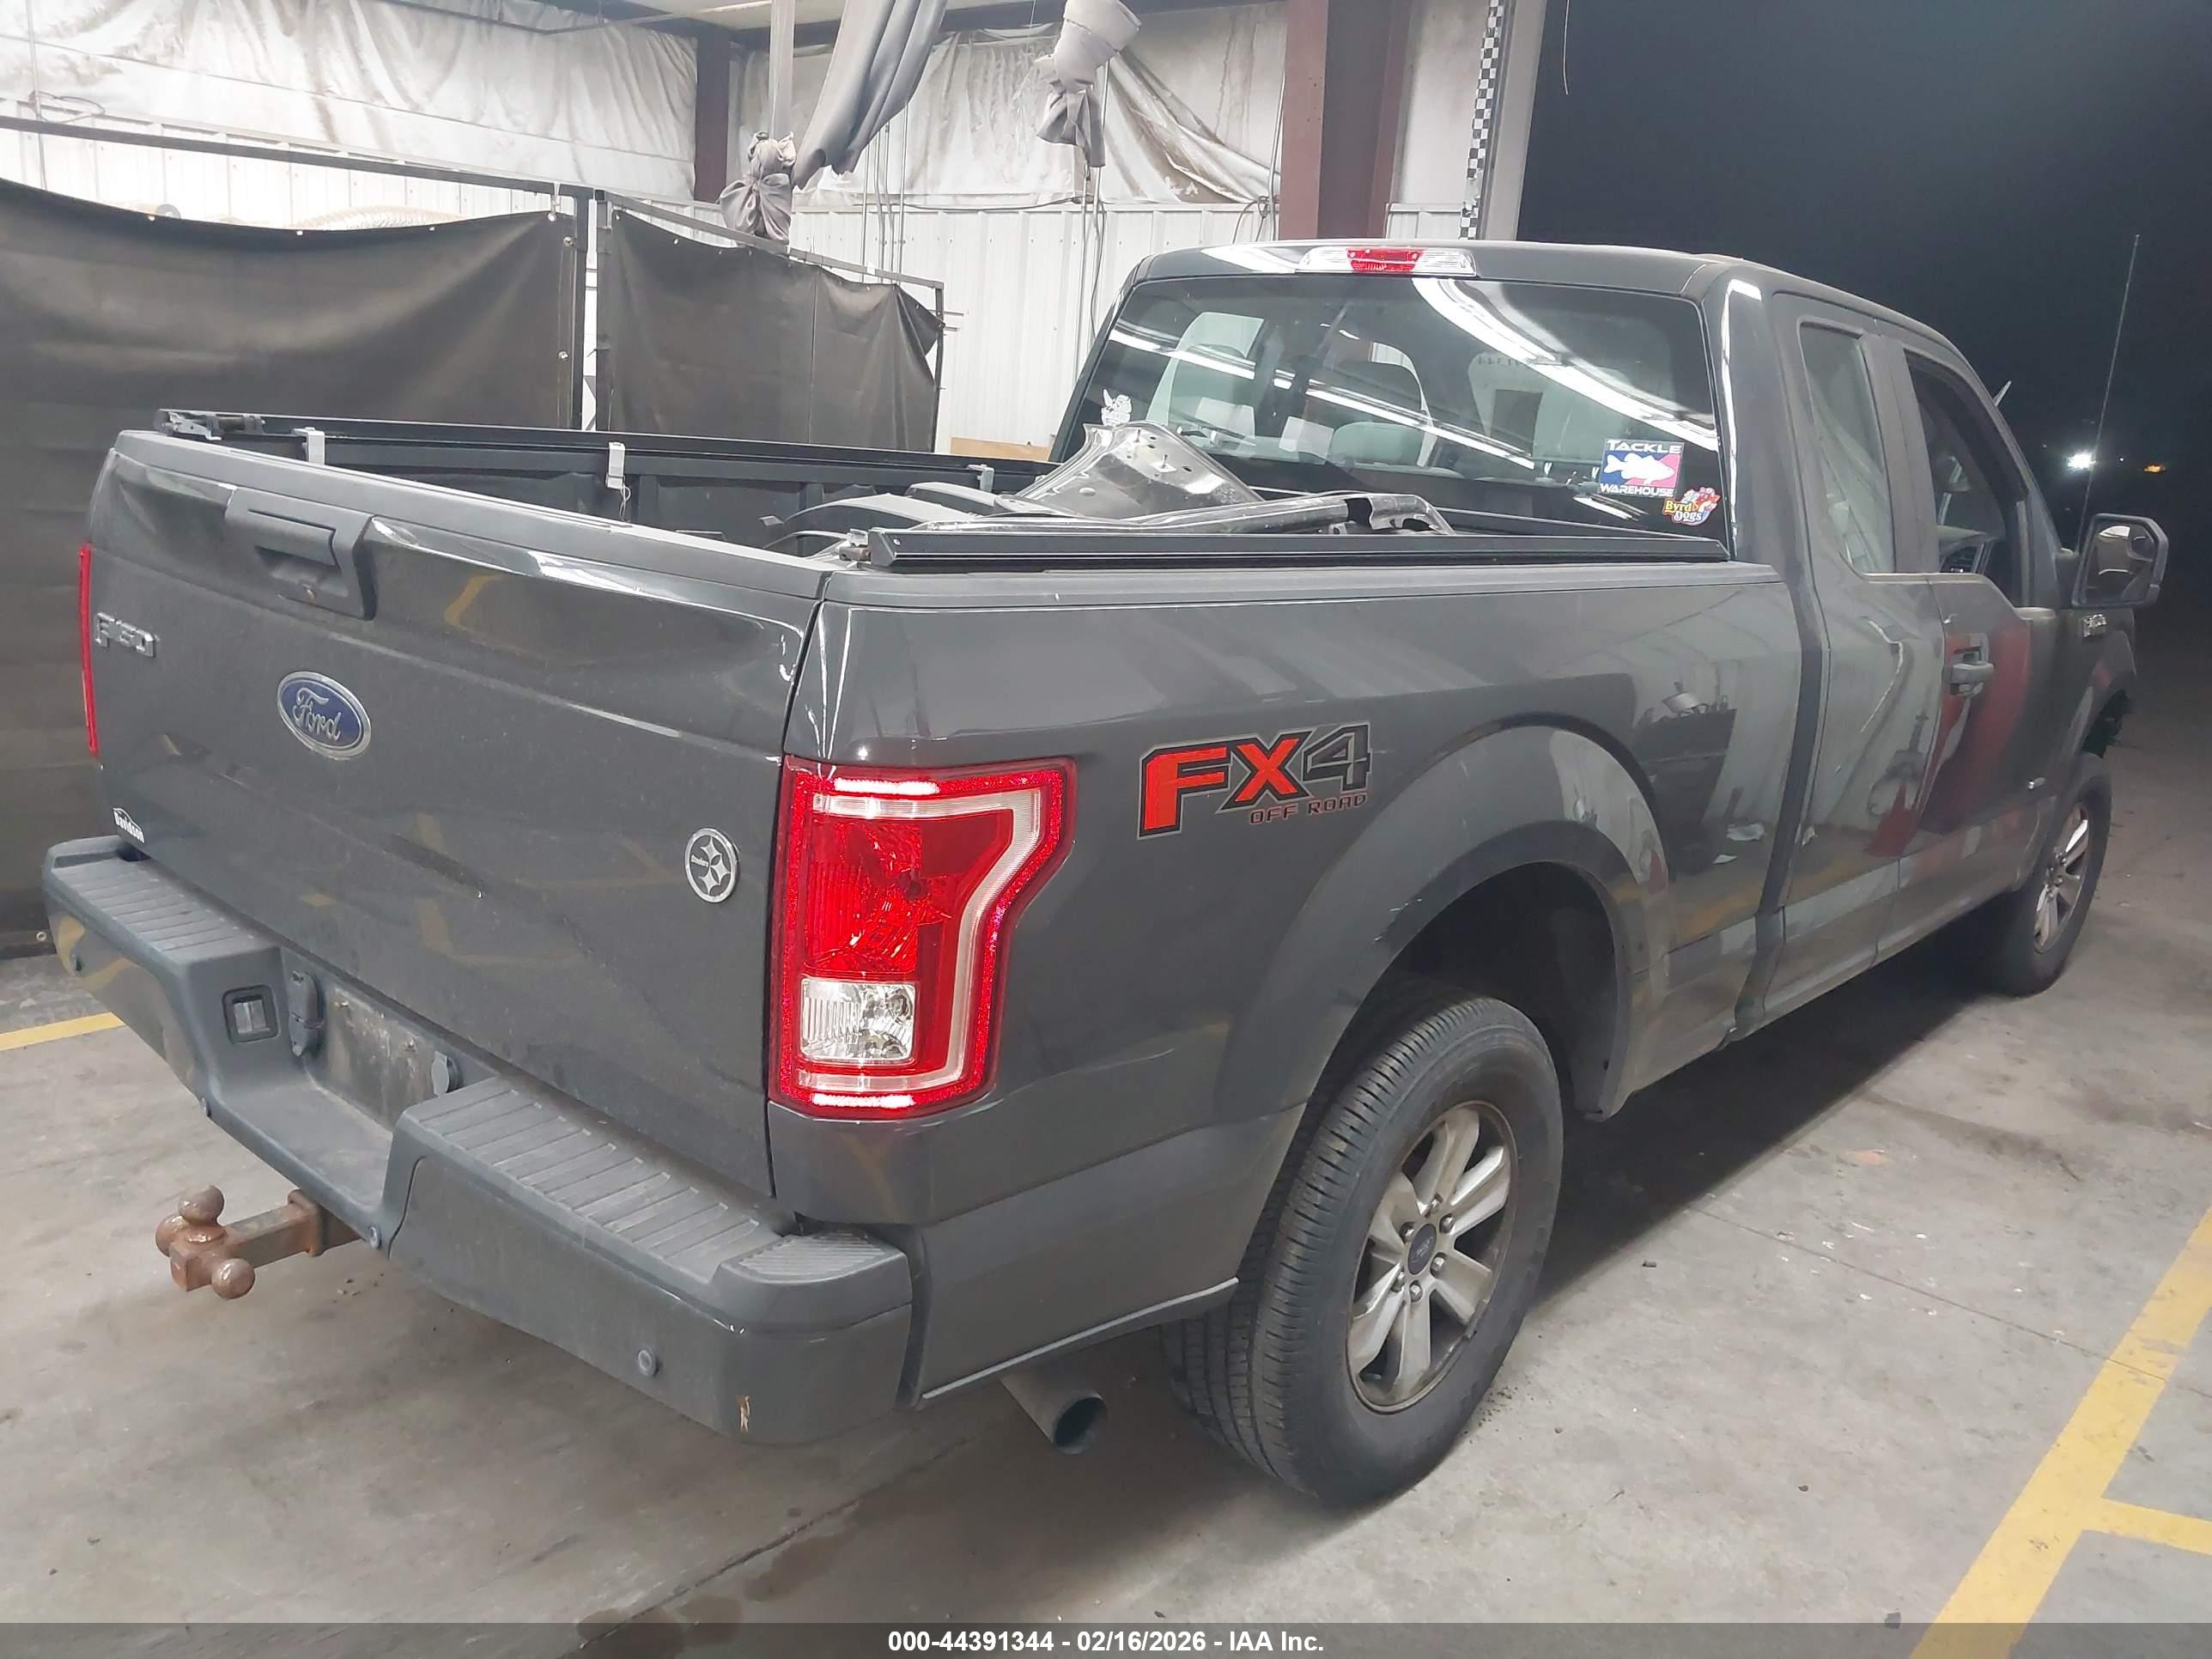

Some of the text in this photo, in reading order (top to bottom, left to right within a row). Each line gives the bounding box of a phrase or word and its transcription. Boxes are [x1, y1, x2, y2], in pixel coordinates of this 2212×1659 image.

[1607, 439, 1682, 453] TACKLE
[1600, 483, 1674, 497] WAREHOUSE
[1674, 511, 1703, 522] Dogs
[292, 686, 342, 742] Ford
[1137, 720, 1372, 841] FX4
[1249, 793, 1369, 825] OFF ROAD
